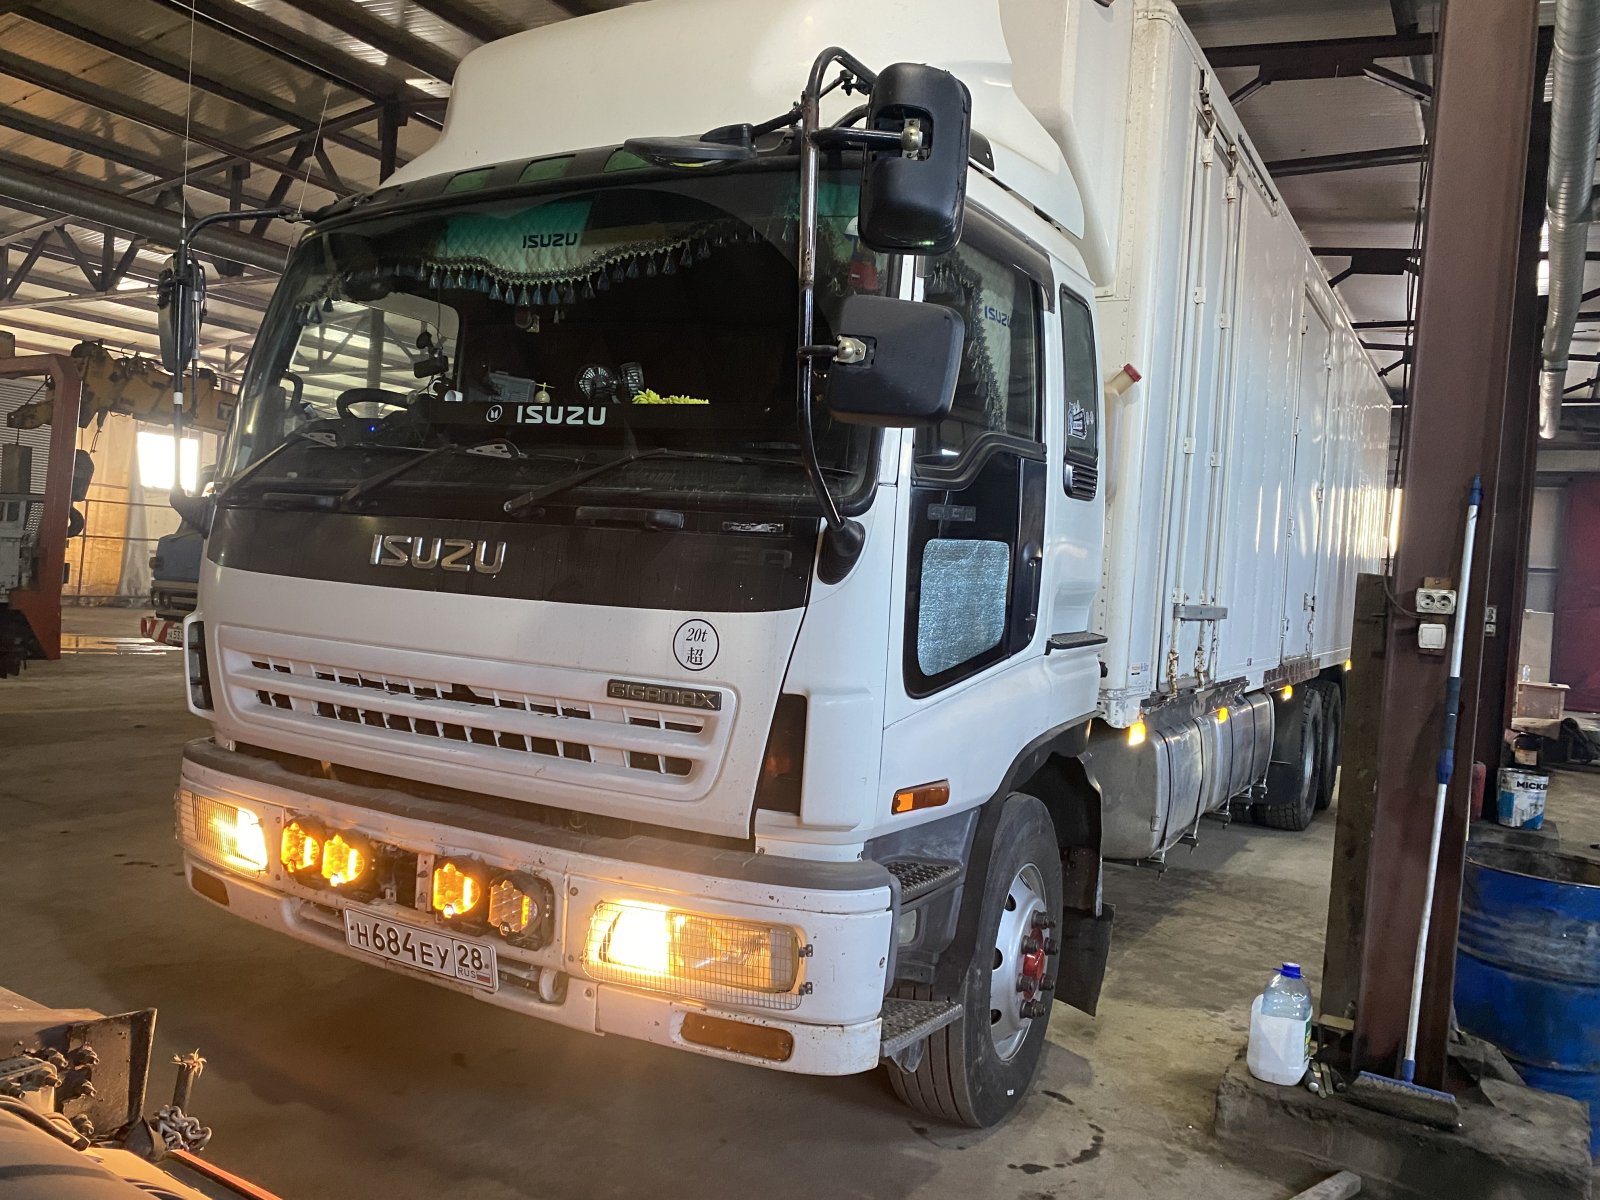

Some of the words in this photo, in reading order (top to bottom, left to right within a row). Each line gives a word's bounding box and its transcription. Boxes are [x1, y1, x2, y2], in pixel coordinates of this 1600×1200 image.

[522, 233, 578, 248] ISUZU
[516, 405, 607, 425] ISUZU
[369, 534, 507, 574] ISUZU
[686, 627, 708, 642] 20t
[610, 682, 716, 708] GIGAMAX
[1516, 780, 1548, 791] MICKI
[457, 944, 483, 971] 28
[457, 966, 476, 979] RUS
